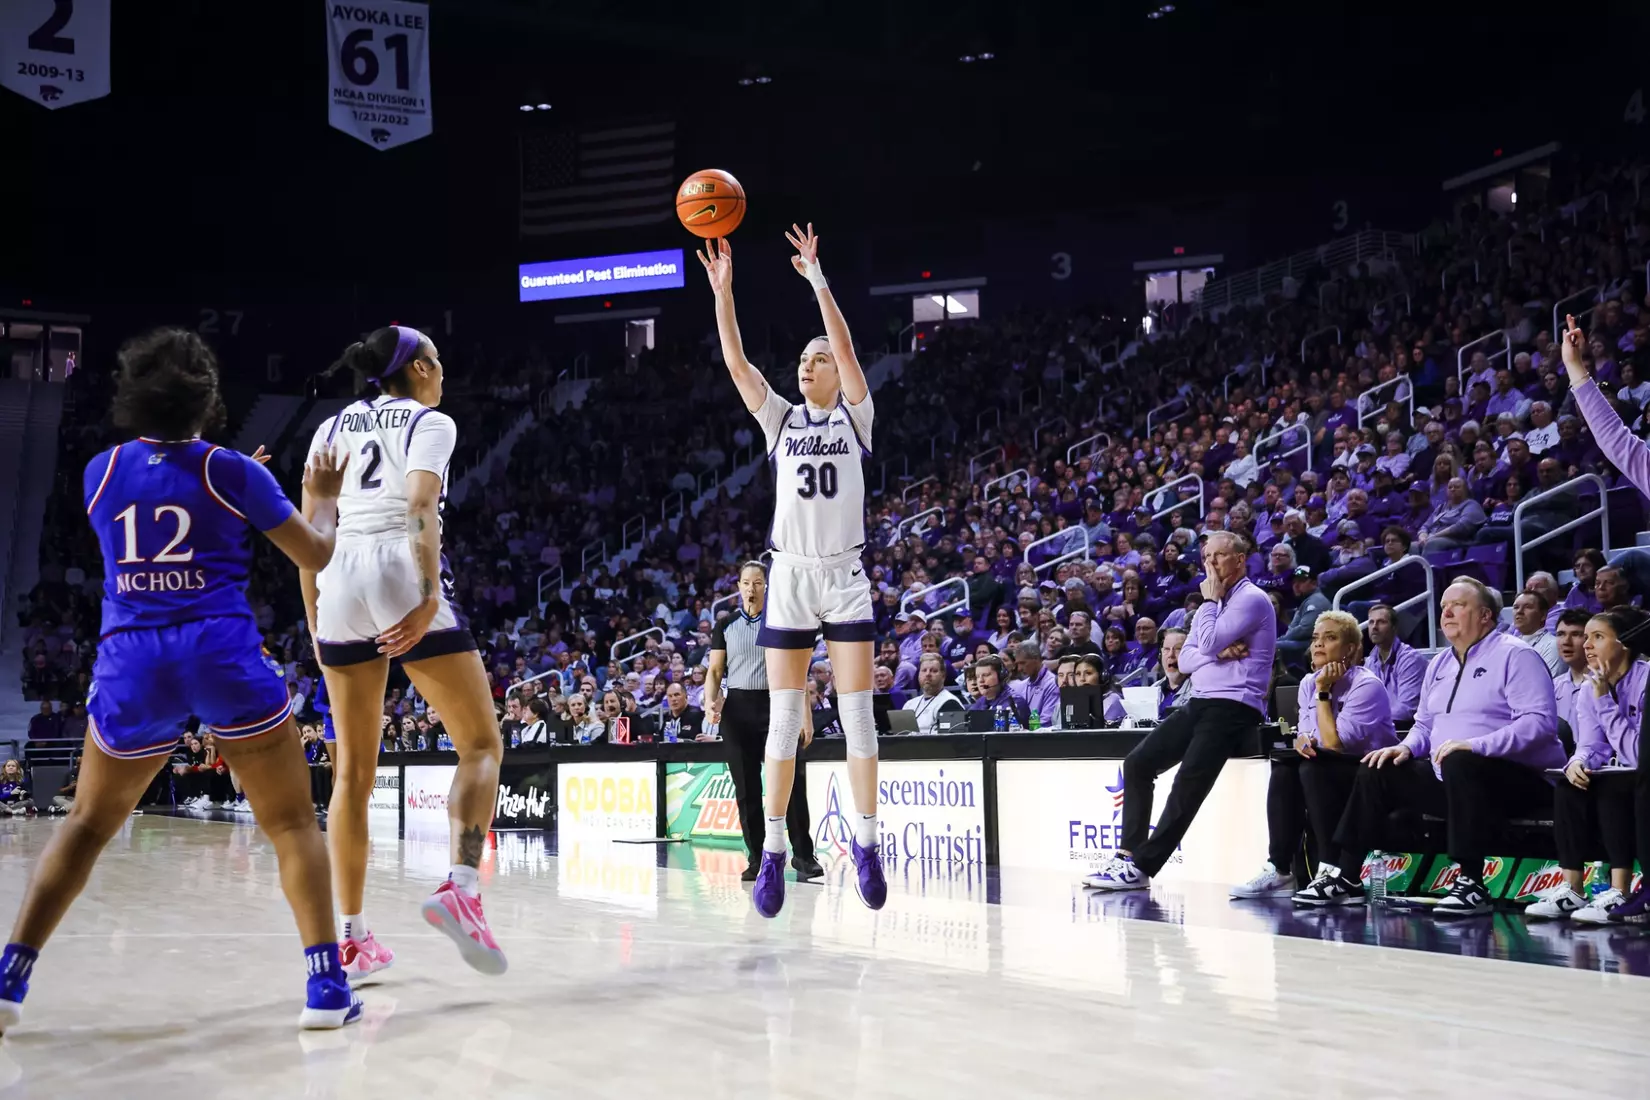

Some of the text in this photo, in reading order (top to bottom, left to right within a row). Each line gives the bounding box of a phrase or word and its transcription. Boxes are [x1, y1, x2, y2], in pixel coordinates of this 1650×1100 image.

[333, 5, 424, 30] AYOKA LEE
[17, 62, 84, 82] 2009-13
[341, 28, 410, 91] 61
[333, 88, 365, 101] NCAA
[366, 92, 418, 107] DIVISION
[1623, 87, 1648, 125] 4
[352, 110, 409, 126] 1/23/2022
[1331, 199, 1349, 231] 3
[521, 262, 677, 288] Guaranteed Pest Elimination
[1050, 251, 1072, 280] 3
[785, 435, 850, 457] Wildcats
[360, 440, 382, 490] 2
[796, 461, 839, 500] 30
[113, 503, 195, 564] 12
[496, 784, 550, 819] Pizza Hut
[566, 776, 654, 822] QDOBA
[878, 769, 976, 807] scension
[877, 821, 983, 863] ia Christi
